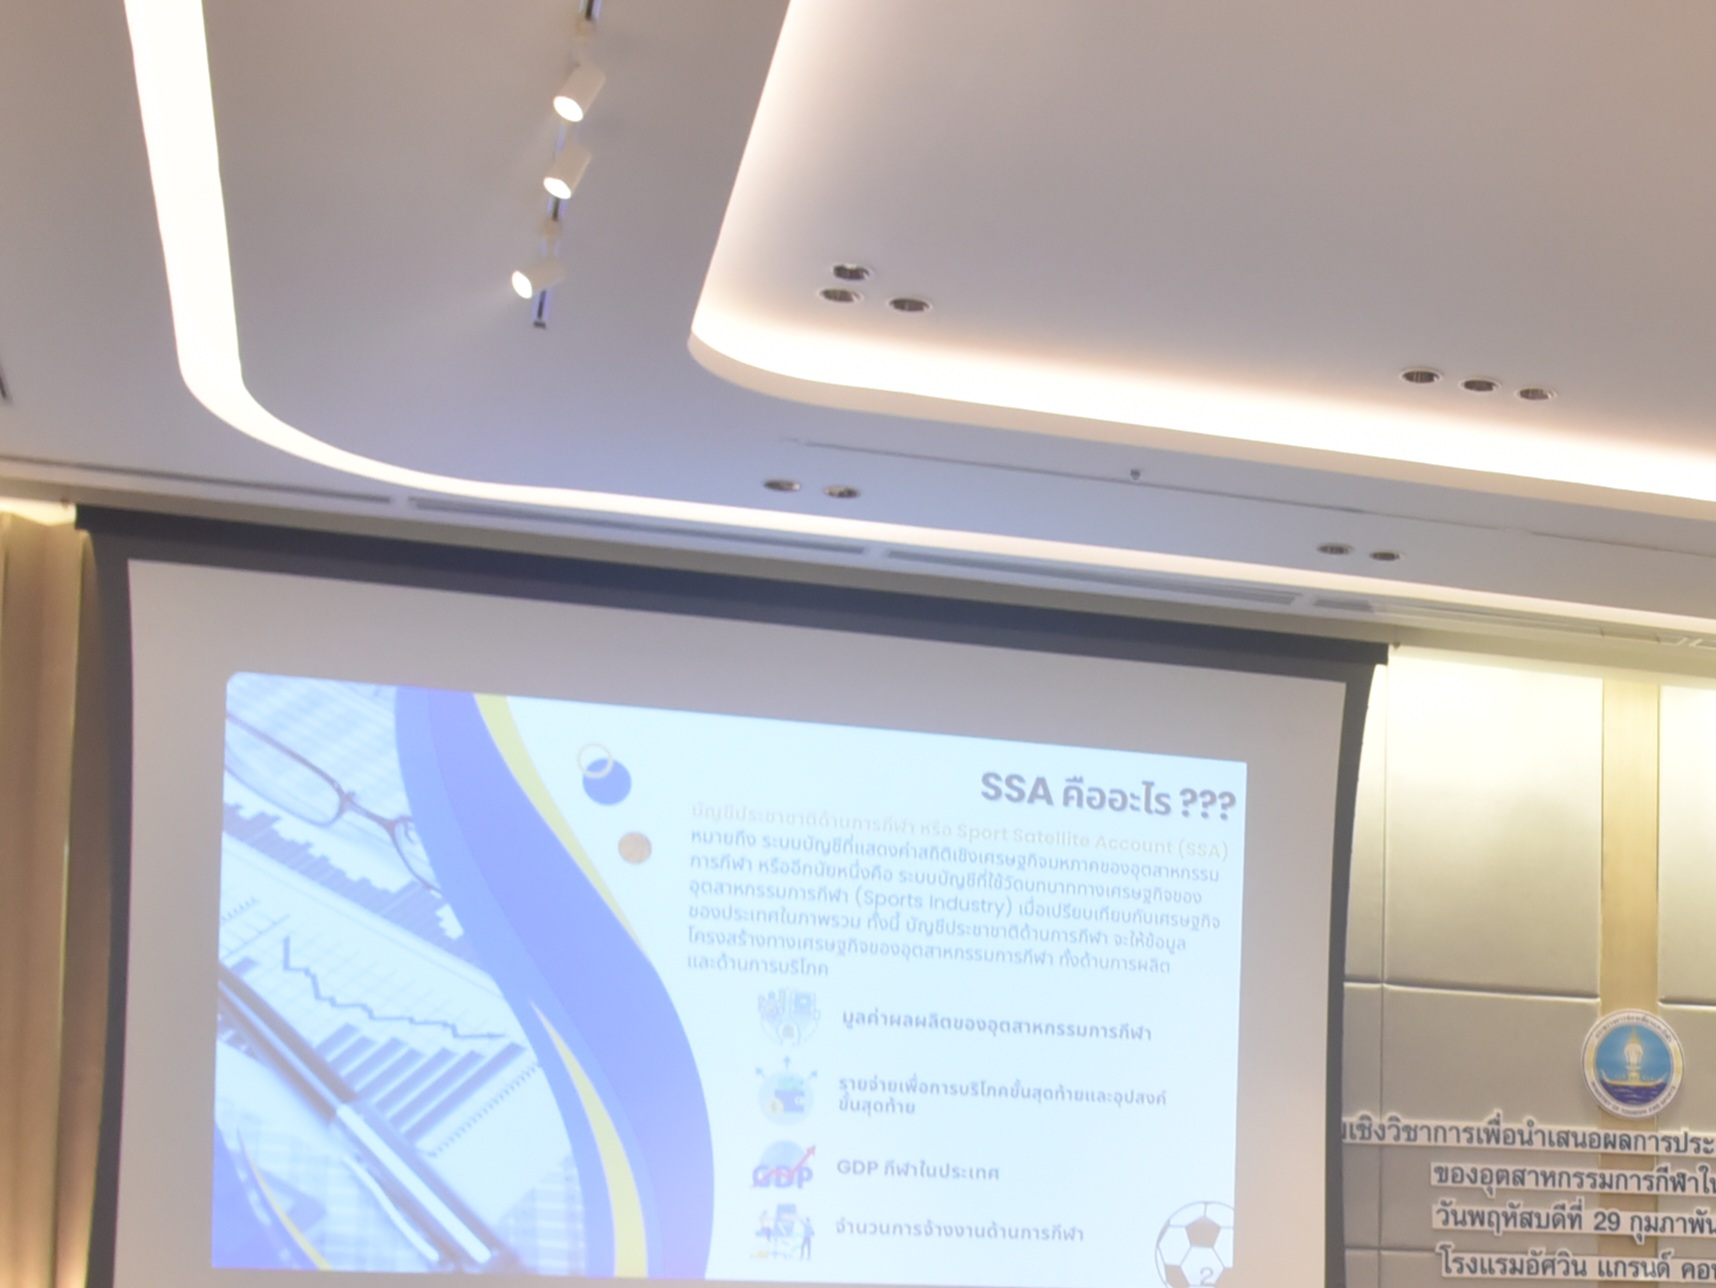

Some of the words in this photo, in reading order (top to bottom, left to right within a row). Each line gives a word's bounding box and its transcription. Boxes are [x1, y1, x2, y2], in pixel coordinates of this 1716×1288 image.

[981, 771, 1054, 806] SSA
[1062, 776, 1172, 816] คืออะไร
[1179, 787, 1237, 821] ???
[691, 828, 756, 847] หมายถึง
[957, 824, 1008, 843] Sport
[1013, 829, 1091, 848] Satellite
[1095, 835, 1173, 855] Account
[1178, 840, 1229, 861] (SSA)
[690, 853, 752, 872] การกีฬา
[689, 878, 849, 903] อุตสาหกรรมการกีฬา
[855, 885, 924, 912] (Sports
[929, 892, 1012, 918] Industry)
[752, 1165, 814, 1189] GDP
[836, 1159, 879, 1175] GDP
[883, 1159, 1000, 1181] กีฬาในประเทศ
[1436, 1198, 1583, 1235] วันพฤหัสบดีที่
[1593, 1211, 1621, 1232] 29
[1199, 1267, 1214, 1287] 2
[1438, 1244, 1588, 1277] โรงแรมอัศวิน
[1597, 1251, 1673, 1280] แกรนด์
